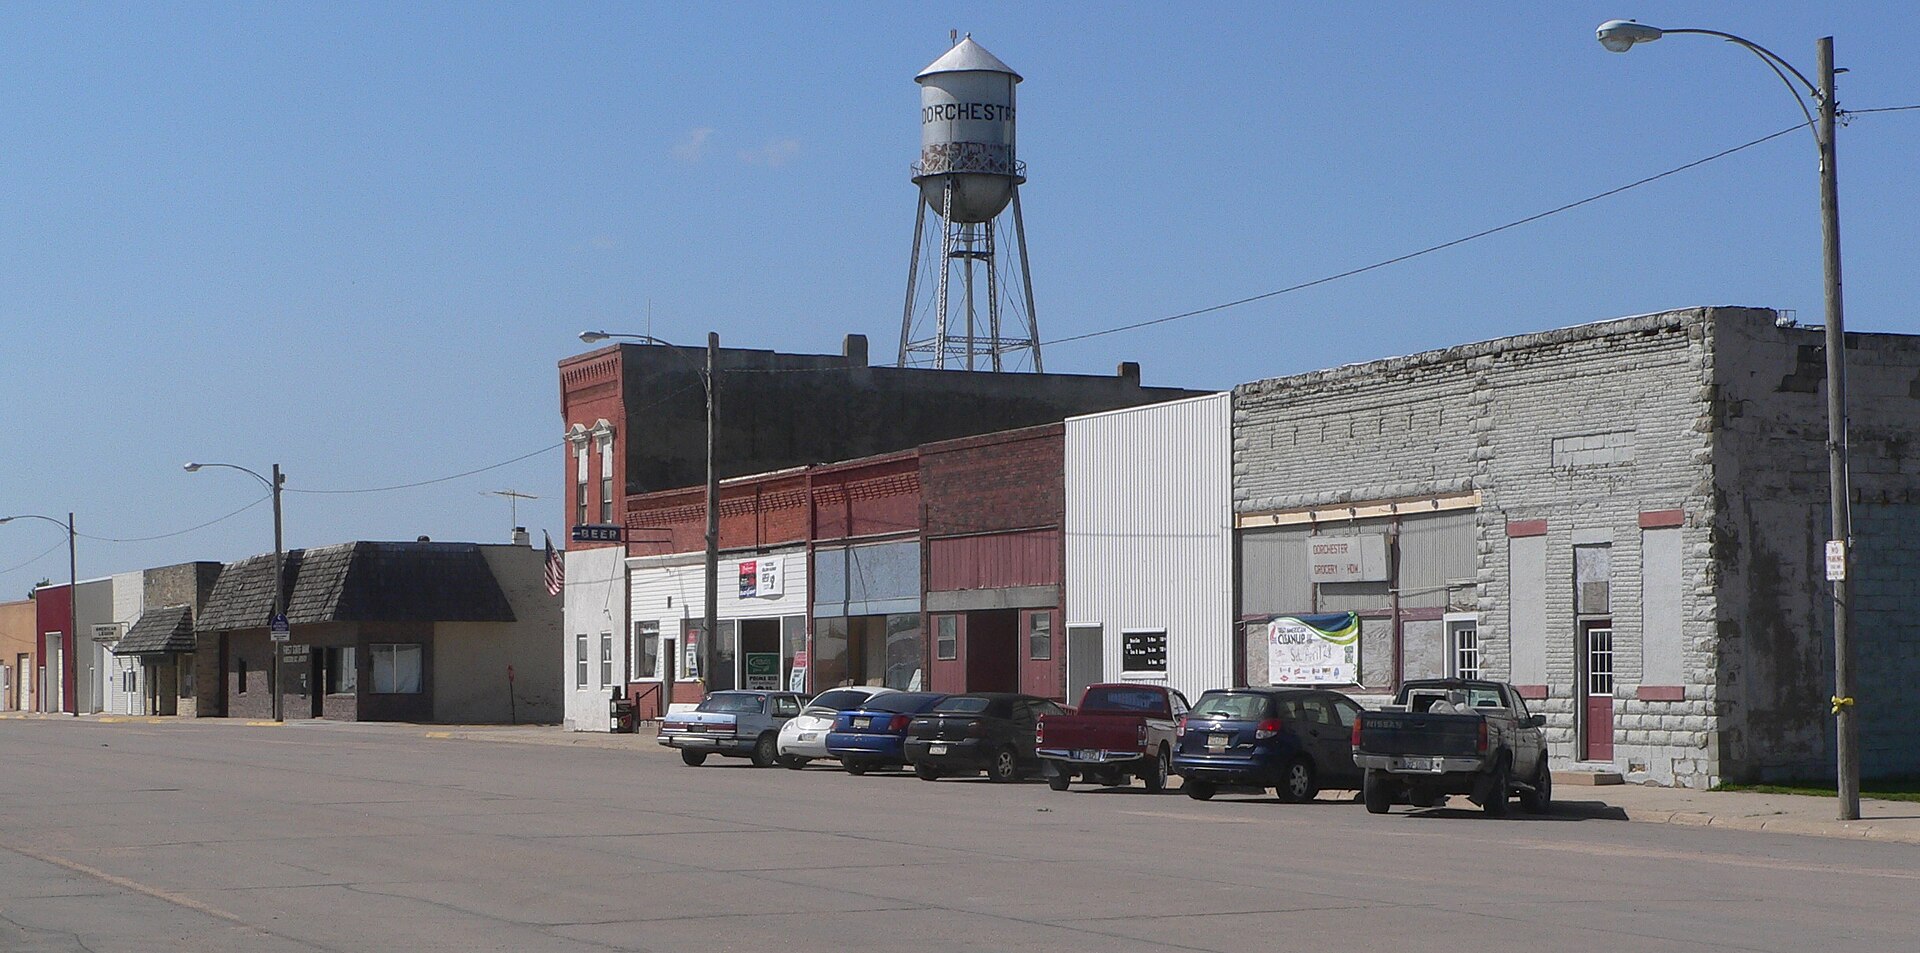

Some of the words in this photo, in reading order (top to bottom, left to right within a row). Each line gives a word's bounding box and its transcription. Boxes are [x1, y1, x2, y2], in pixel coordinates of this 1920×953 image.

[922, 103, 1015, 124] DORCHESTE
[581, 529, 617, 539] BEER
[1313, 544, 1348, 554] DORCHESTER
[1314, 564, 1337, 574] GROCERY
[1277, 633, 1306, 644] CLEANUP
